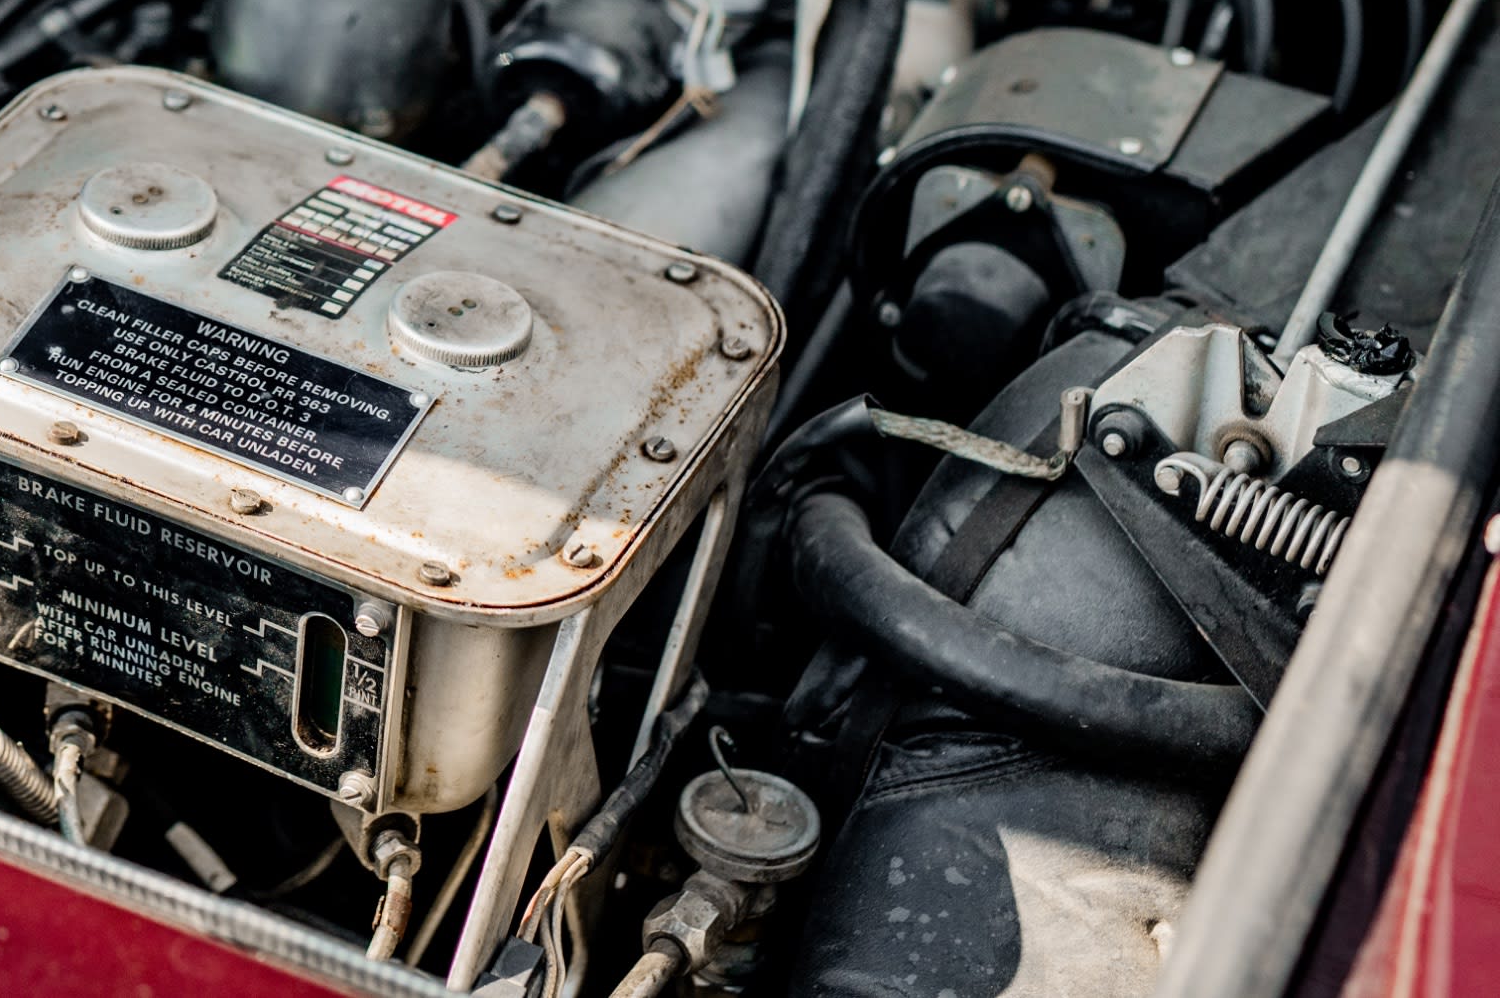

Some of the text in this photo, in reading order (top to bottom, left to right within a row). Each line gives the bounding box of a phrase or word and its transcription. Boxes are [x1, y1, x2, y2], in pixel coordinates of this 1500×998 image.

[77, 299, 392, 422] CLEAN FILLER CAPS BEFORE REMOVING.
[113, 327, 331, 415] USE ONLY CASTROL RR 363
[113, 343, 312, 423] BRAKE FLUID TO D.O.T. 3
[196, 321, 291, 365] WARNING
[48, 352, 345, 469] RUN ENGINE FOR 4 MINUTES BEFORE
[55, 369, 318, 476] TOPPING UP WITH CAR UNLADEN.
[89, 350, 318, 443] FROM A SEALED CONTAINER.
[18, 475, 272, 586] BRAKE FLUID RESERVOIR
[43, 544, 234, 628] TOP UP TO THIS LEVEL
[60, 589, 218, 664] MINIMUM LEVEL
[34, 628, 163, 687] FOR 4 MINUTES
[34, 616, 241, 708] AFTER RUNNING ENGINE
[35, 602, 206, 678] WITH CAR UNLADEN
[352, 663, 377, 694] 1/2
[348, 686, 378, 707] PINT
